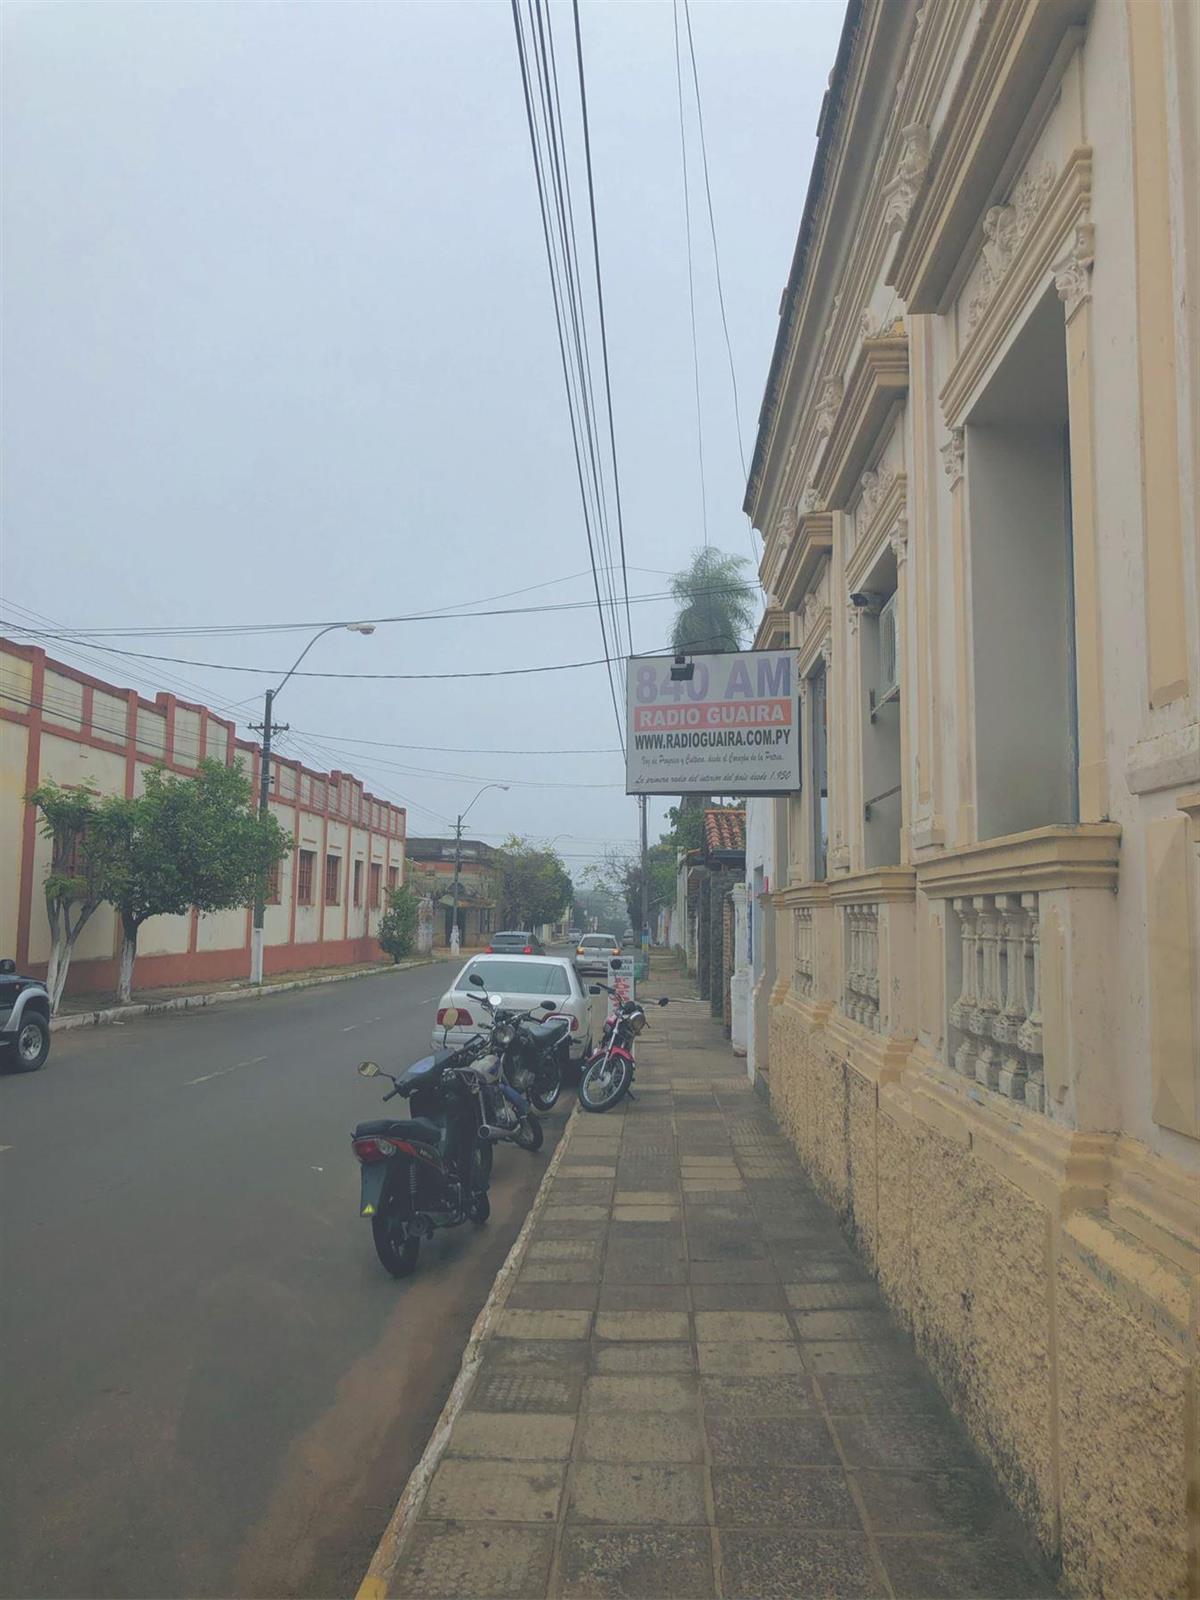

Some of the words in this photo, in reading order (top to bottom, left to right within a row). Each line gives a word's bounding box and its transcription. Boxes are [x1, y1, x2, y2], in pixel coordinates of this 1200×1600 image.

[636, 662, 709, 703] 840
[724, 656, 791, 697] AM
[639, 707, 700, 726] RADIO
[706, 703, 784, 724] GUAIRA
[634, 728, 791, 750] WWW.RADIOGUAIRA.COM.PY
[671, 774, 687, 783] radio
[688, 773, 699, 782] del
[723, 772, 735, 781] del
[749, 770, 767, 781] desde
